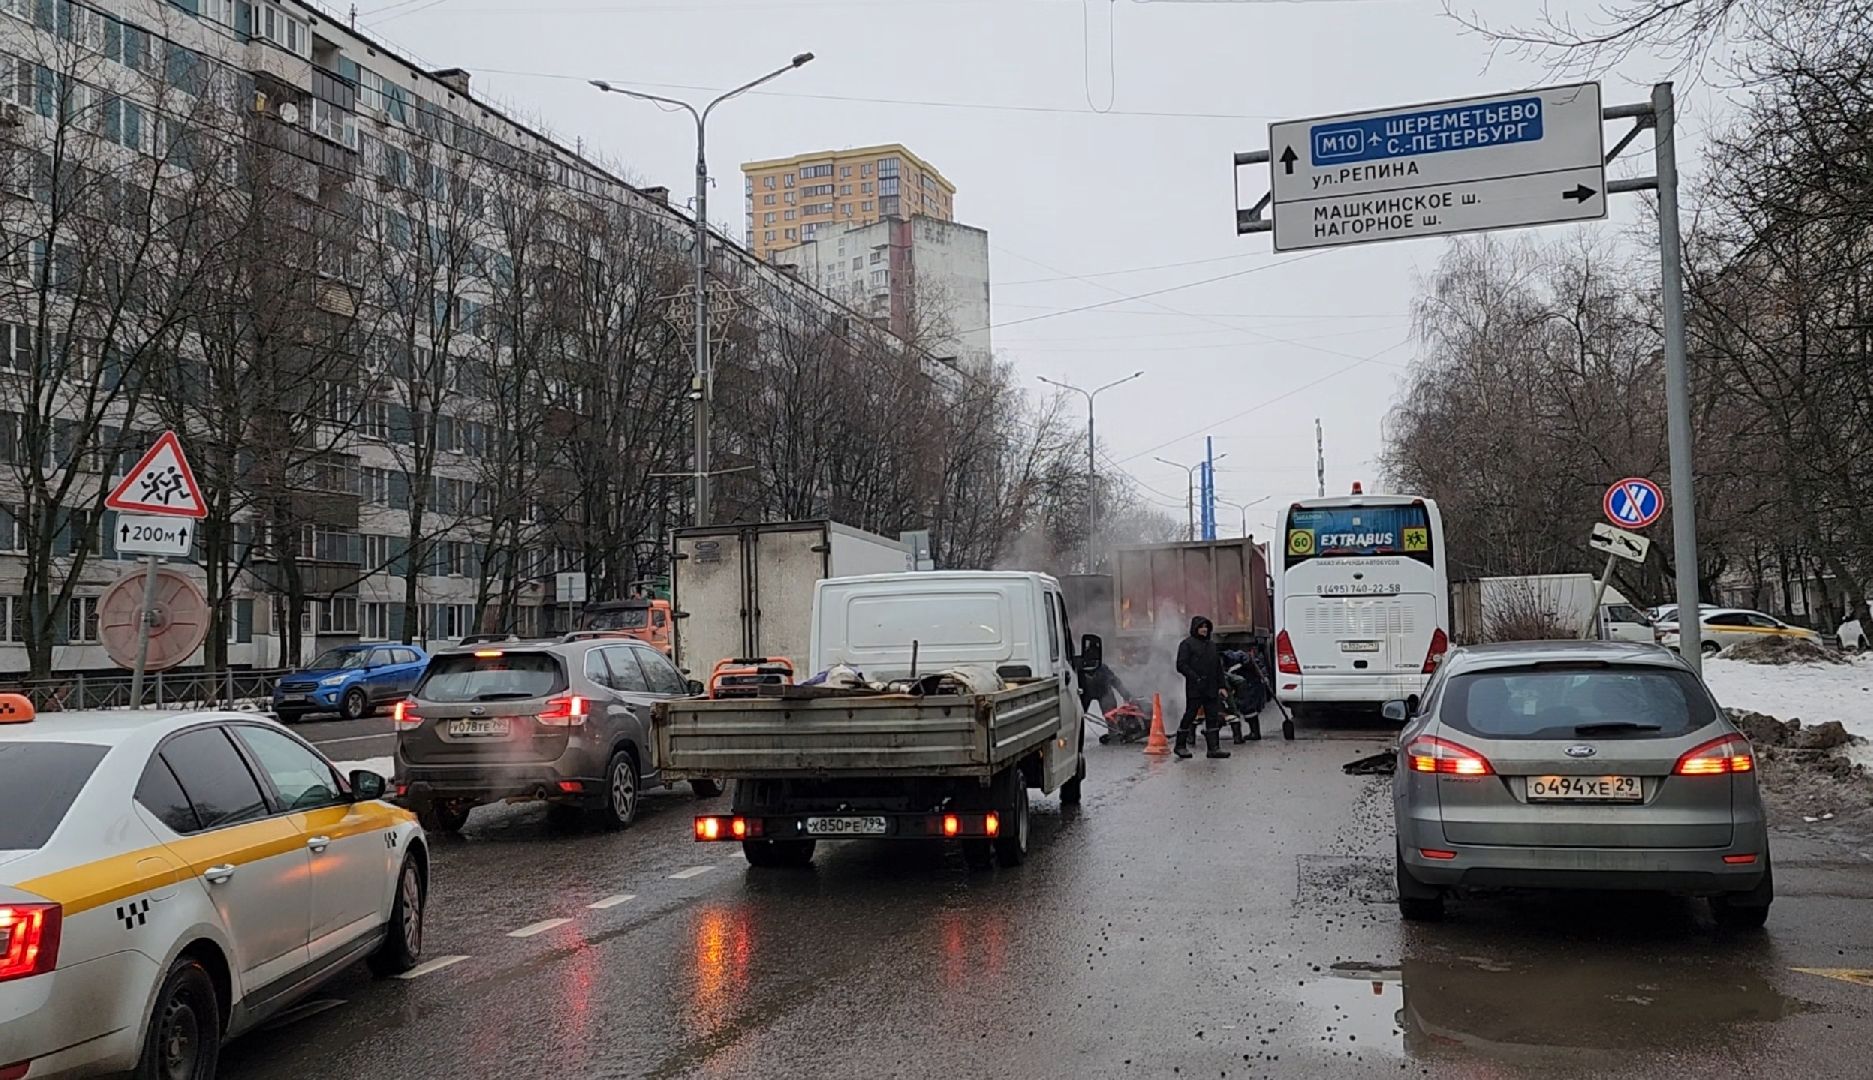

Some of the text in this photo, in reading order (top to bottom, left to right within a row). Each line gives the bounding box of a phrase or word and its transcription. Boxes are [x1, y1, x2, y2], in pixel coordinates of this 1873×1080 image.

[1385, 103, 1539, 136] ШЕРЕМЕТЬЕВО
[1322, 134, 1357, 153] М10
[1387, 122, 1529, 154] С.-ПЕТЕРБУРГ
[1314, 192, 1481, 220] МАШКИНСКОЕ ш.
[1314, 213, 1442, 238] НАГОРНОЕ ш.
[132, 525, 175, 542] 200м
[1293, 537, 1308, 548] 60
[1320, 532, 1394, 547] EXTRABUS
[1350, 583, 1401, 593] 740-22-58
[1615, 778, 1634, 792] 29
